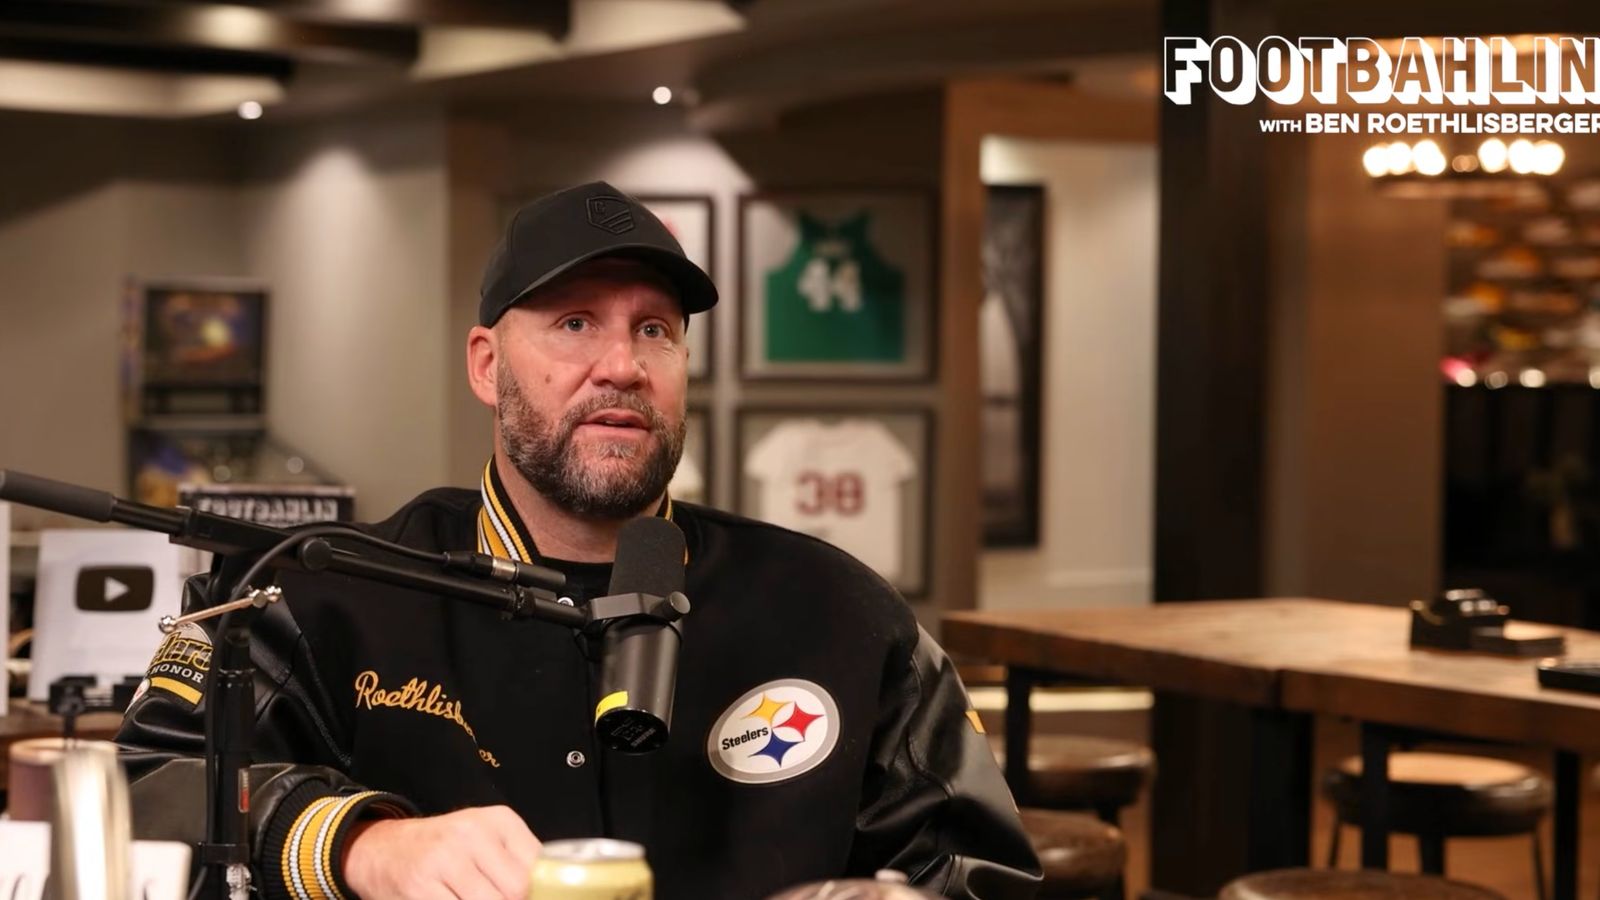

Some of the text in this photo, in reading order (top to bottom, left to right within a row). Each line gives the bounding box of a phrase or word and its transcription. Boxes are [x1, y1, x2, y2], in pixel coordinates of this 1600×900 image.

[797, 258, 861, 313] 44
[151, 663, 204, 684] HONOR
[721, 726, 769, 750] Steelers
